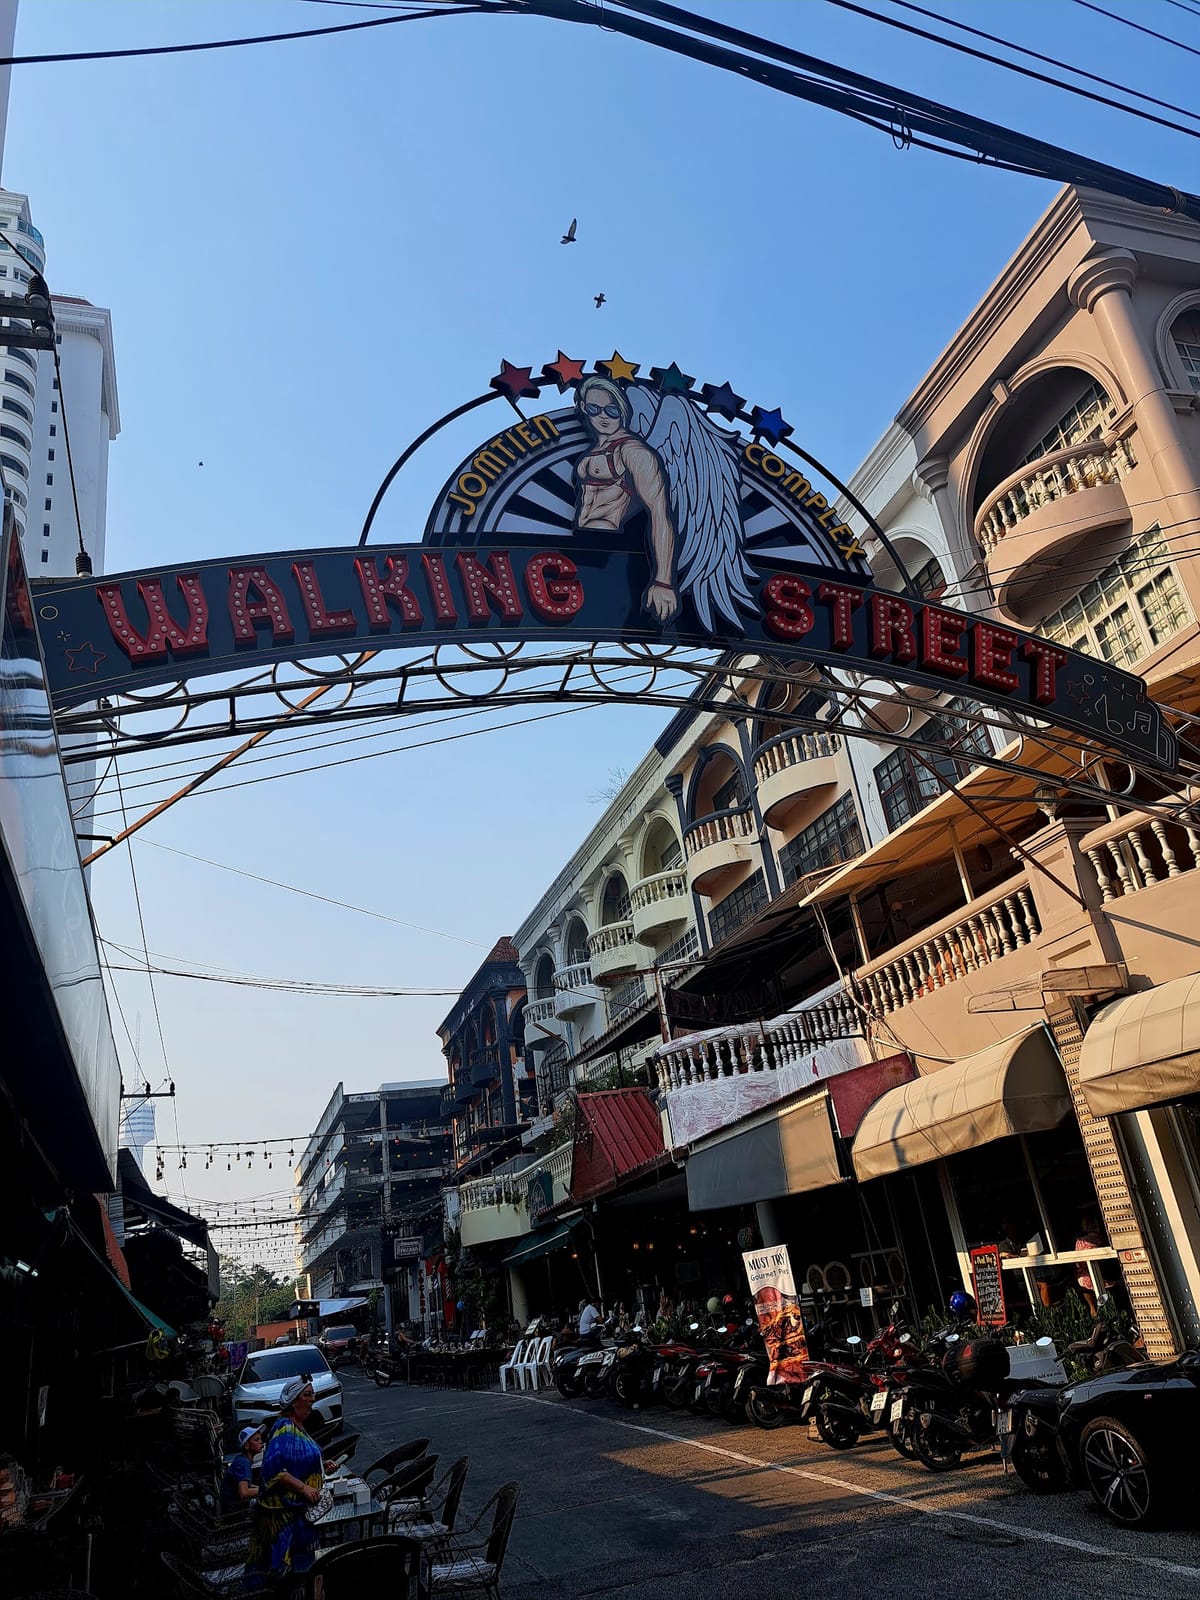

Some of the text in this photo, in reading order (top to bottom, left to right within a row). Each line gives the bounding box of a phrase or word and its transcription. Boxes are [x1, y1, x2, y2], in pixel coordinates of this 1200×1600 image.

[448, 415, 867, 562] JOMTIEN COMPLEX
[96, 551, 1068, 701] WALKING STREET
[748, 1253, 785, 1271] MUST TRY
[751, 1271, 776, 1281] Gourmet
